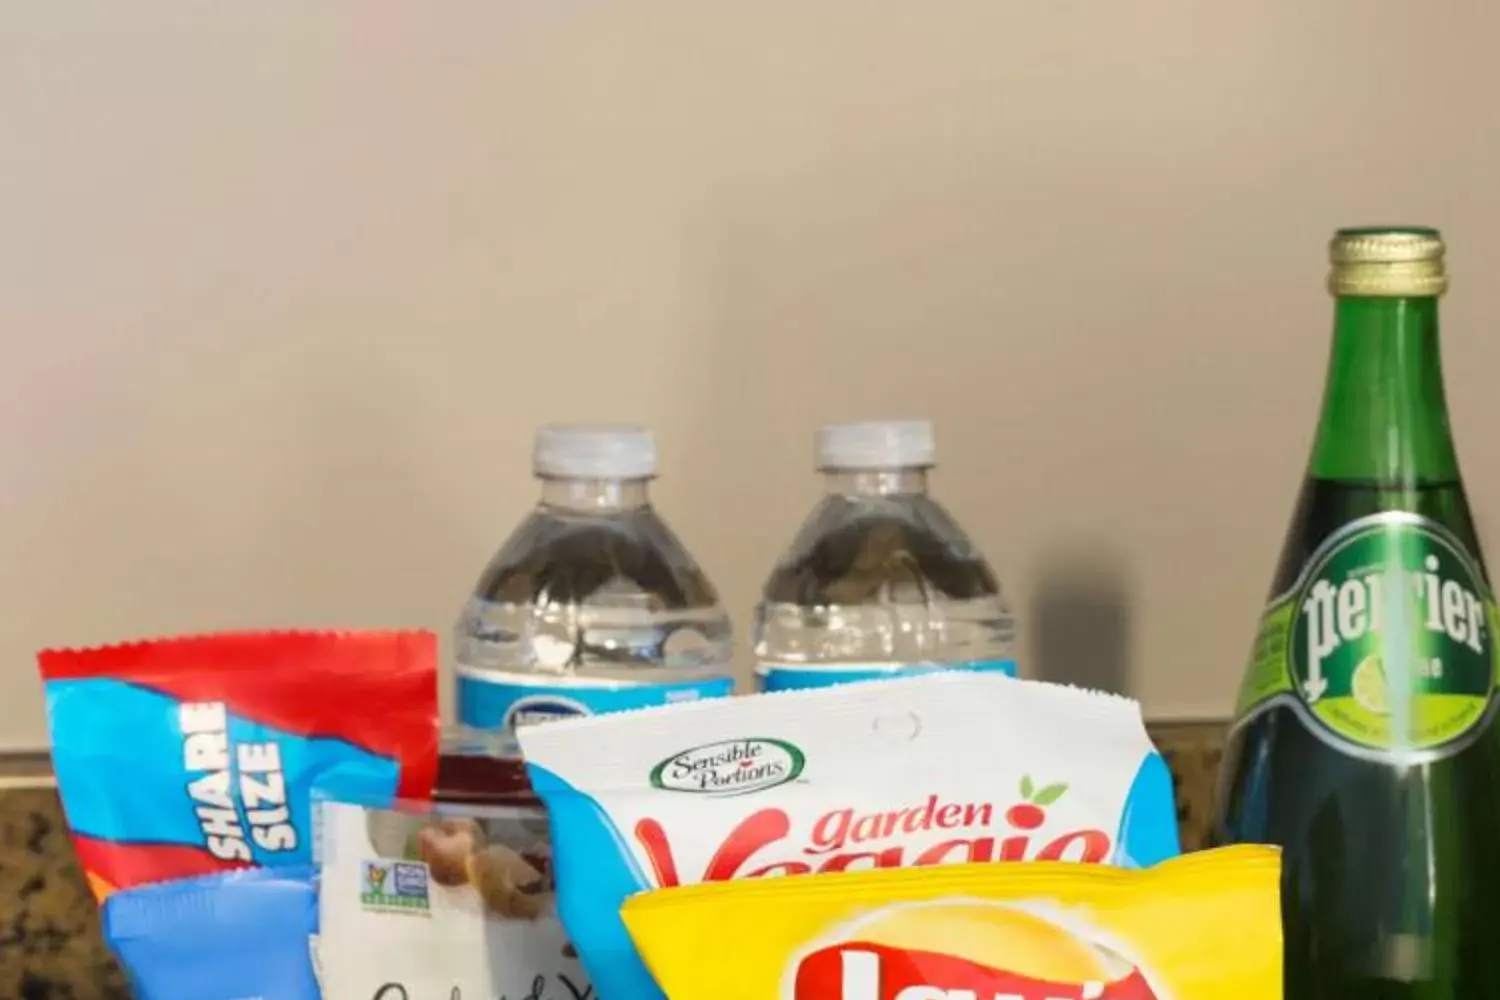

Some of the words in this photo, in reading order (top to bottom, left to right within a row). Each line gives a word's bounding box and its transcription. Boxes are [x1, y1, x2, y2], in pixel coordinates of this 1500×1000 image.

[1302, 554, 1485, 703] perier
[180, 701, 253, 863] SHARE
[237, 741, 298, 851] SIZE
[672, 741, 762, 779] Sensible
[694, 759, 784, 789] Portions
[803, 795, 992, 857] garden
